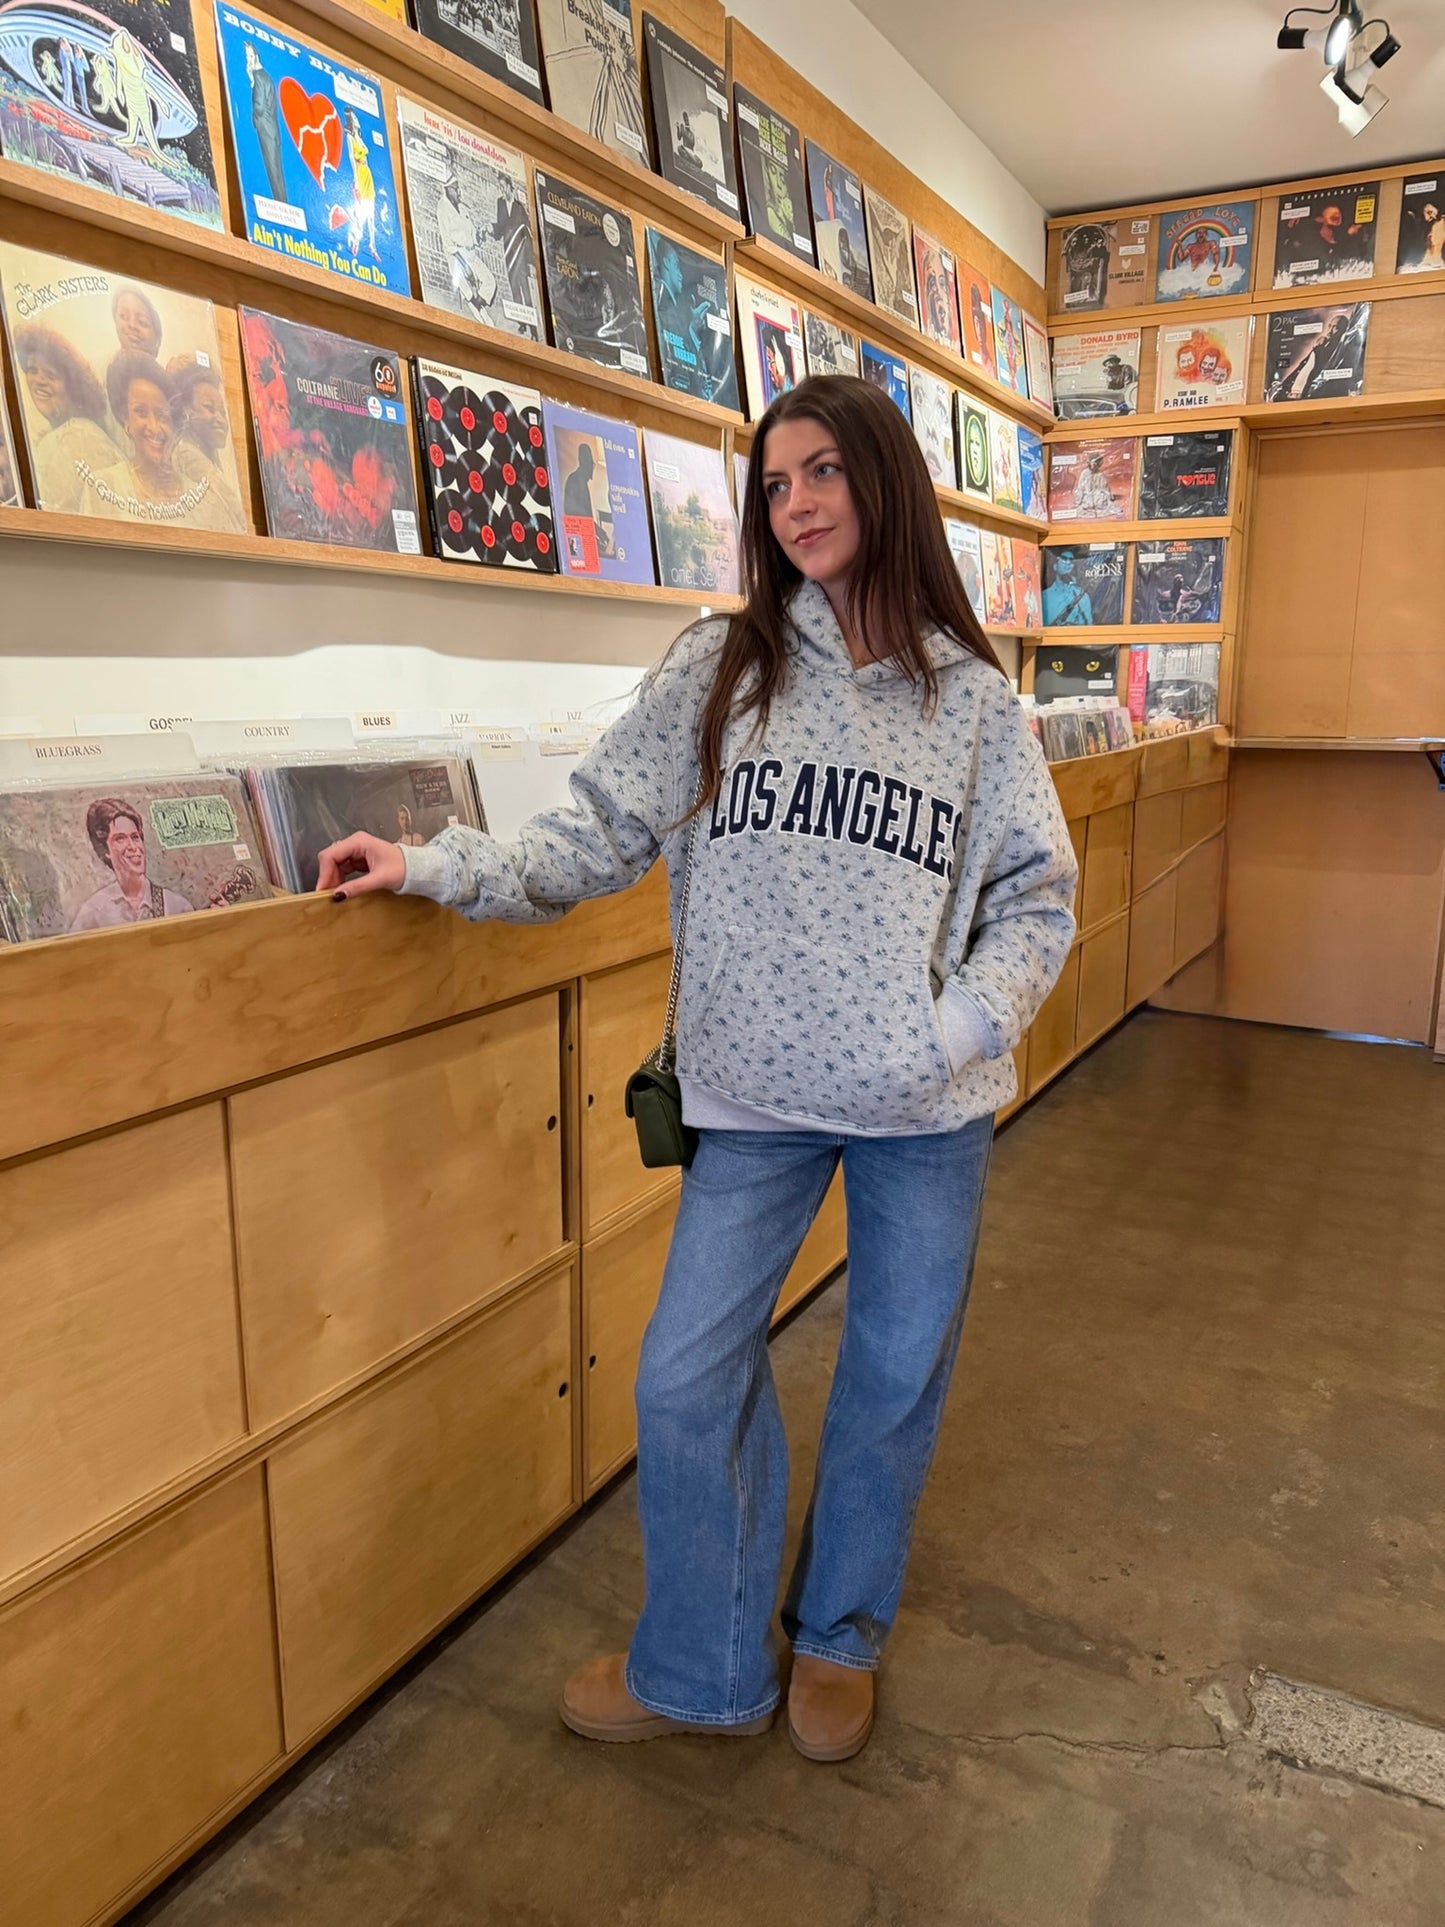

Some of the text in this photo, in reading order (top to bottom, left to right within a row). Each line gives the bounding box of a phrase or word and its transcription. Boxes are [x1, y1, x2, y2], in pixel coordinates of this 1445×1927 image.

[567, 0, 610, 41] Breaking
[223, 10, 301, 58] BOBBY
[308, 54, 377, 97] BLAND
[547, 191, 581, 217] CLEVELAND
[582, 208, 602, 227] EATON
[253, 222, 387, 286] Ain't Nothing You Can Do
[16, 275, 109, 316] CLARK SISTERS
[1081, 331, 1139, 345] DONALD BYRD
[296, 377, 340, 400] COLTRANE
[323, 397, 343, 411] VILLAGE
[362, 716, 391, 726] BLUES
[450, 713, 470, 726] JAZZ
[567, 711, 583, 721] JAZZ
[149, 717, 193, 732] GOS
[244, 725, 291, 737] COUNTRY
[35, 744, 102, 758] BLUEGRASS
[709, 759, 784, 843] LOS
